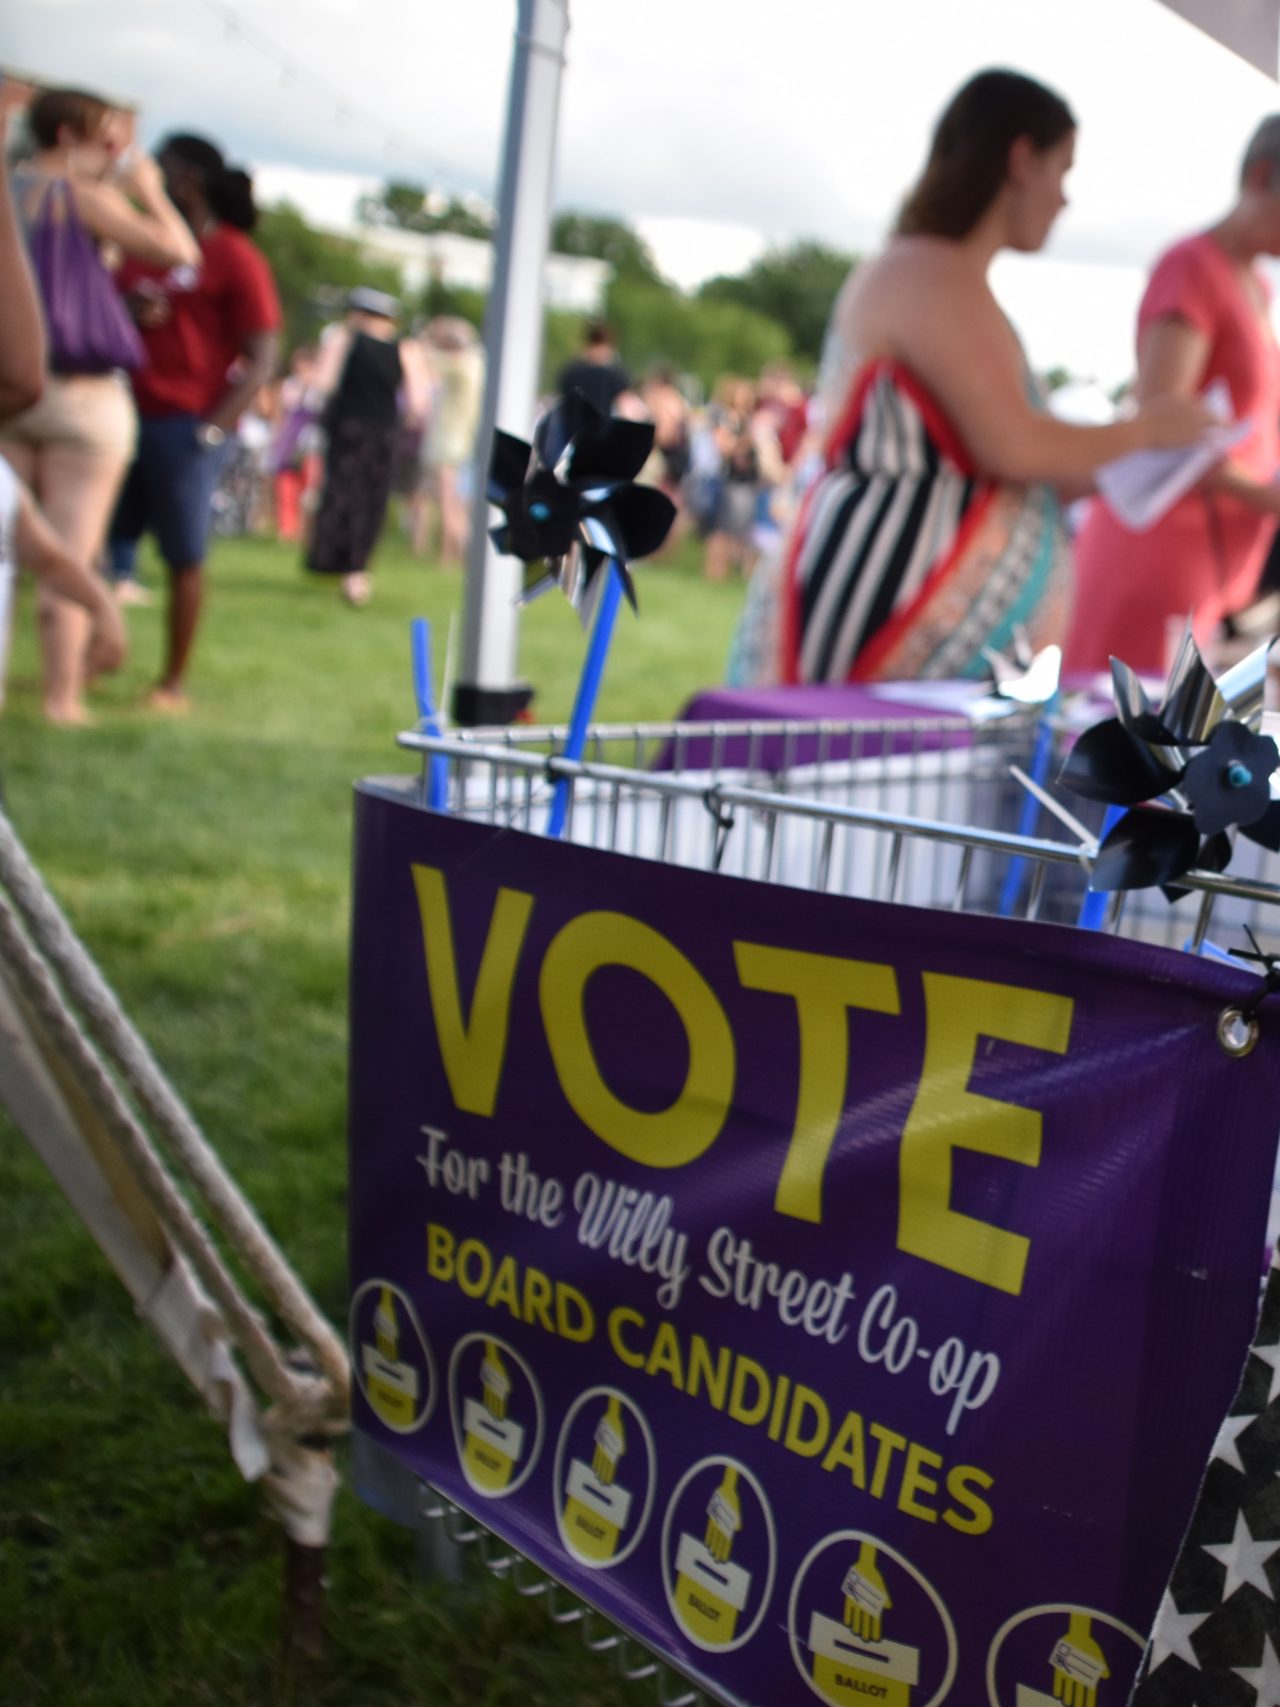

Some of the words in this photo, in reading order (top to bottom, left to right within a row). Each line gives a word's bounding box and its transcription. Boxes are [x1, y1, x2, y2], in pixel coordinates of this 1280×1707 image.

[411, 863, 1074, 1296] VOTE
[416, 1125, 489, 1199] For
[498, 1153, 563, 1228] the
[573, 1172, 690, 1310] Willy
[698, 1227, 856, 1345] Street
[858, 1284, 1001, 1436] Co-op
[427, 1222, 596, 1343] BOARD
[608, 1307, 994, 1536] CANDIDATES
[834, 1673, 888, 1699] BALLOT
